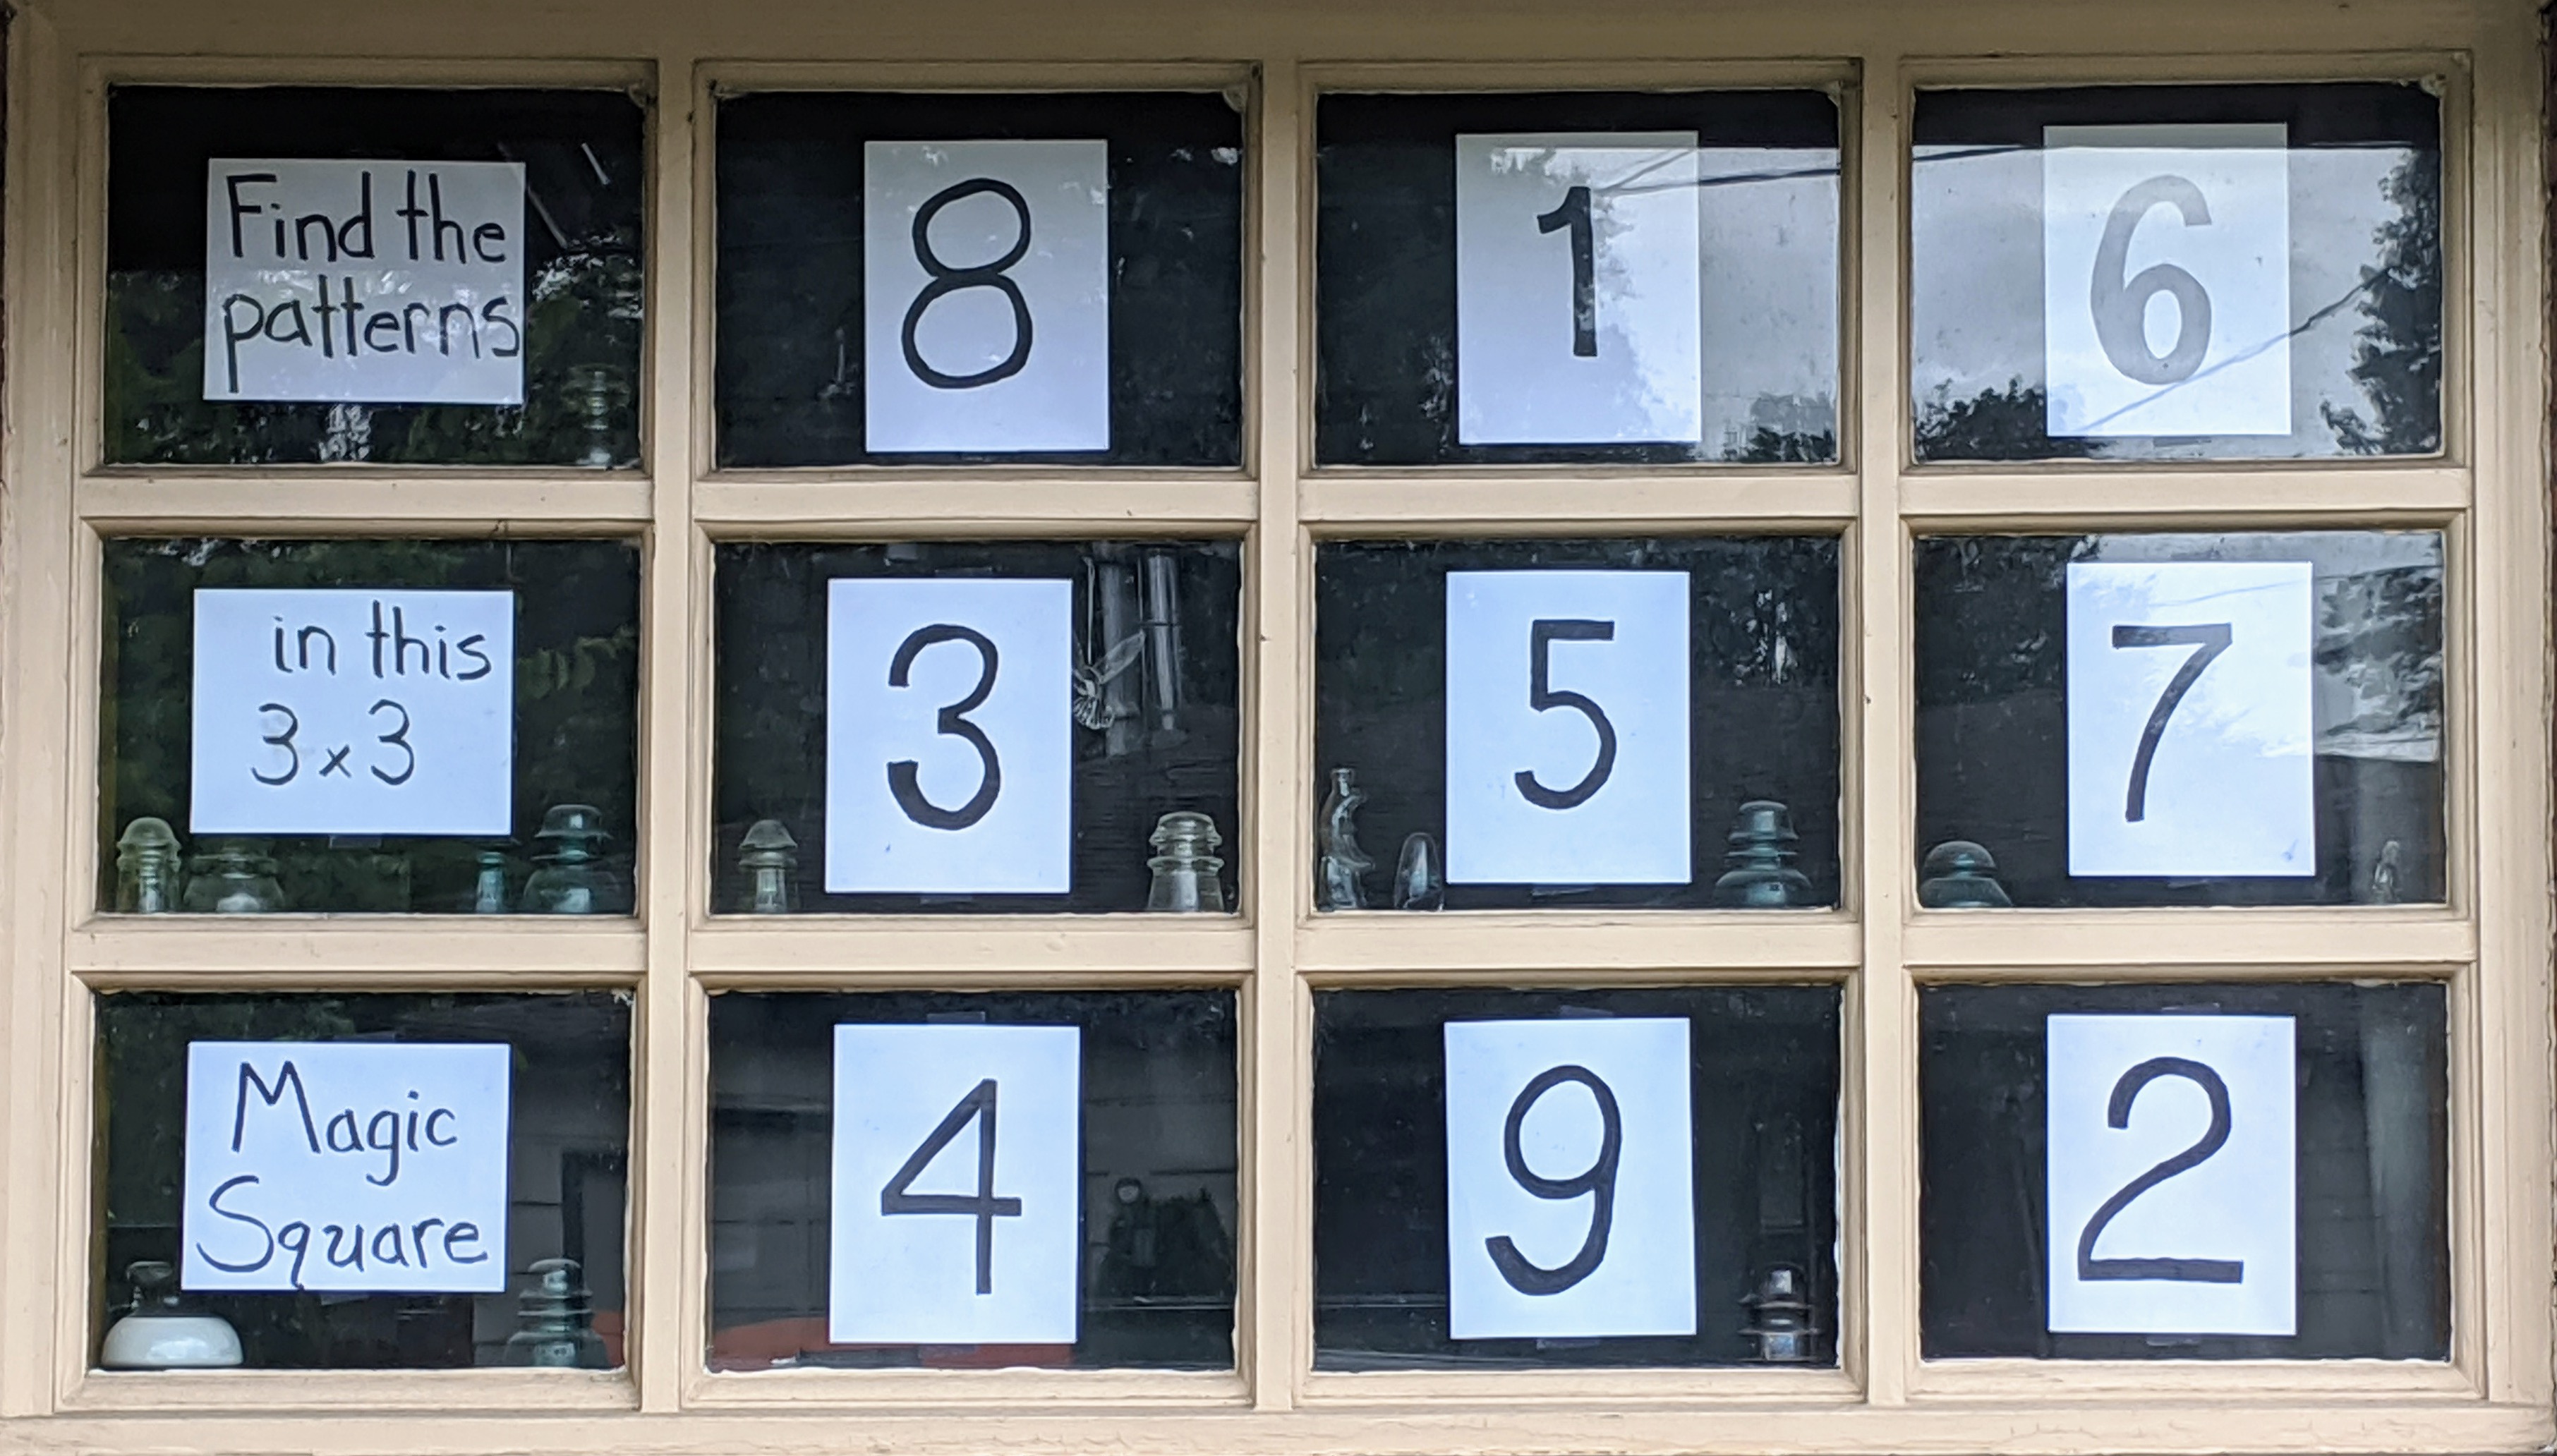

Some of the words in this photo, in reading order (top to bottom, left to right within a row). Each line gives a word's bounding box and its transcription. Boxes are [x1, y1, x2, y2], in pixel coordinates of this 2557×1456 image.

[226, 171, 376, 263] Find
[397, 169, 507, 265] the
[901, 178, 1033, 389] 8
[1536, 185, 1597, 358] 1
[2089, 174, 2213, 384] 6
[222, 273, 521, 394] patterns
[274, 616, 337, 675] in
[365, 600, 492, 681] this
[886, 624, 1002, 831] 3
[1514, 618, 1616, 810] 5
[2112, 622, 2233, 823] 7
[231, 1060, 457, 1187] Magic
[881, 1077, 1022, 1295] 4
[1485, 1064, 1622, 1296] 9
[2077, 1055, 2244, 1284] 2
[195, 1175, 488, 1290] Square
